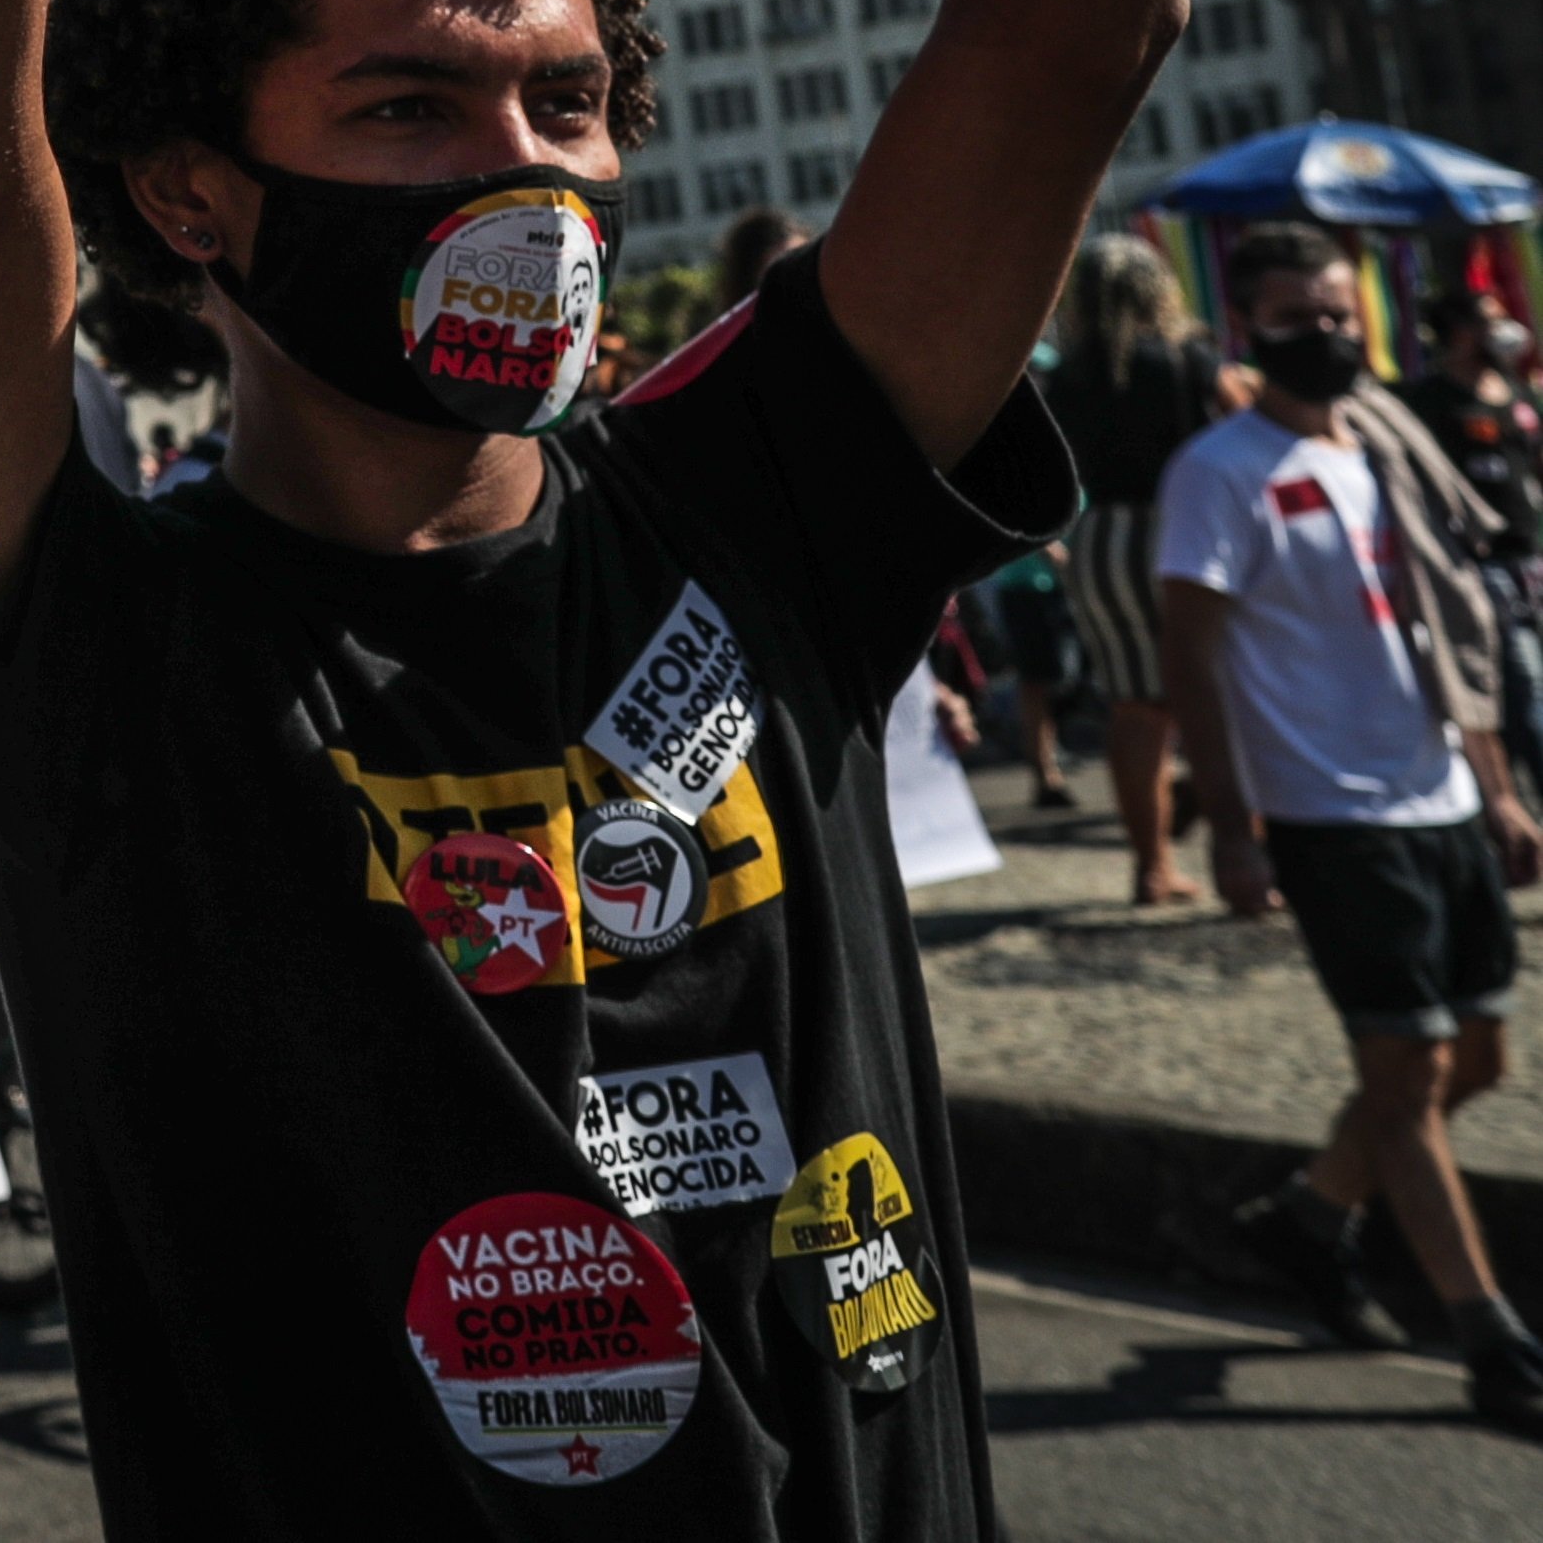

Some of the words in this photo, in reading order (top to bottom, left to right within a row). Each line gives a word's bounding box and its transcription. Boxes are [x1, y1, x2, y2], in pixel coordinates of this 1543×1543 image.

[441, 278, 560, 322] FORA
[436, 313, 571, 356] BOLSO
[611, 608, 721, 752] #FORA
[649, 638, 740, 774] BOLSONARO
[596, 802, 659, 823] VACINA
[431, 852, 544, 892] LULA
[499, 915, 535, 938] PT
[587, 921, 693, 956] ANTIFASCISTA
[583, 1069, 750, 1138] #FORA
[589, 1120, 762, 1168] BOLSONARO
[599, 1153, 766, 1203] ENOCIDA
[438, 1223, 634, 1270] VACINA
[824, 1230, 905, 1301] FORA
[448, 1273, 500, 1301] NO
[511, 1261, 644, 1297] BRAÇO.
[455, 1294, 650, 1341] COMIDA
[828, 1268, 937, 1359] BOLSONARO
[462, 1343, 514, 1371] NO
[525, 1332, 648, 1366] PRATO.
[477, 1390, 554, 1426] FORA
[555, 1387, 667, 1426] BOLSONARO
